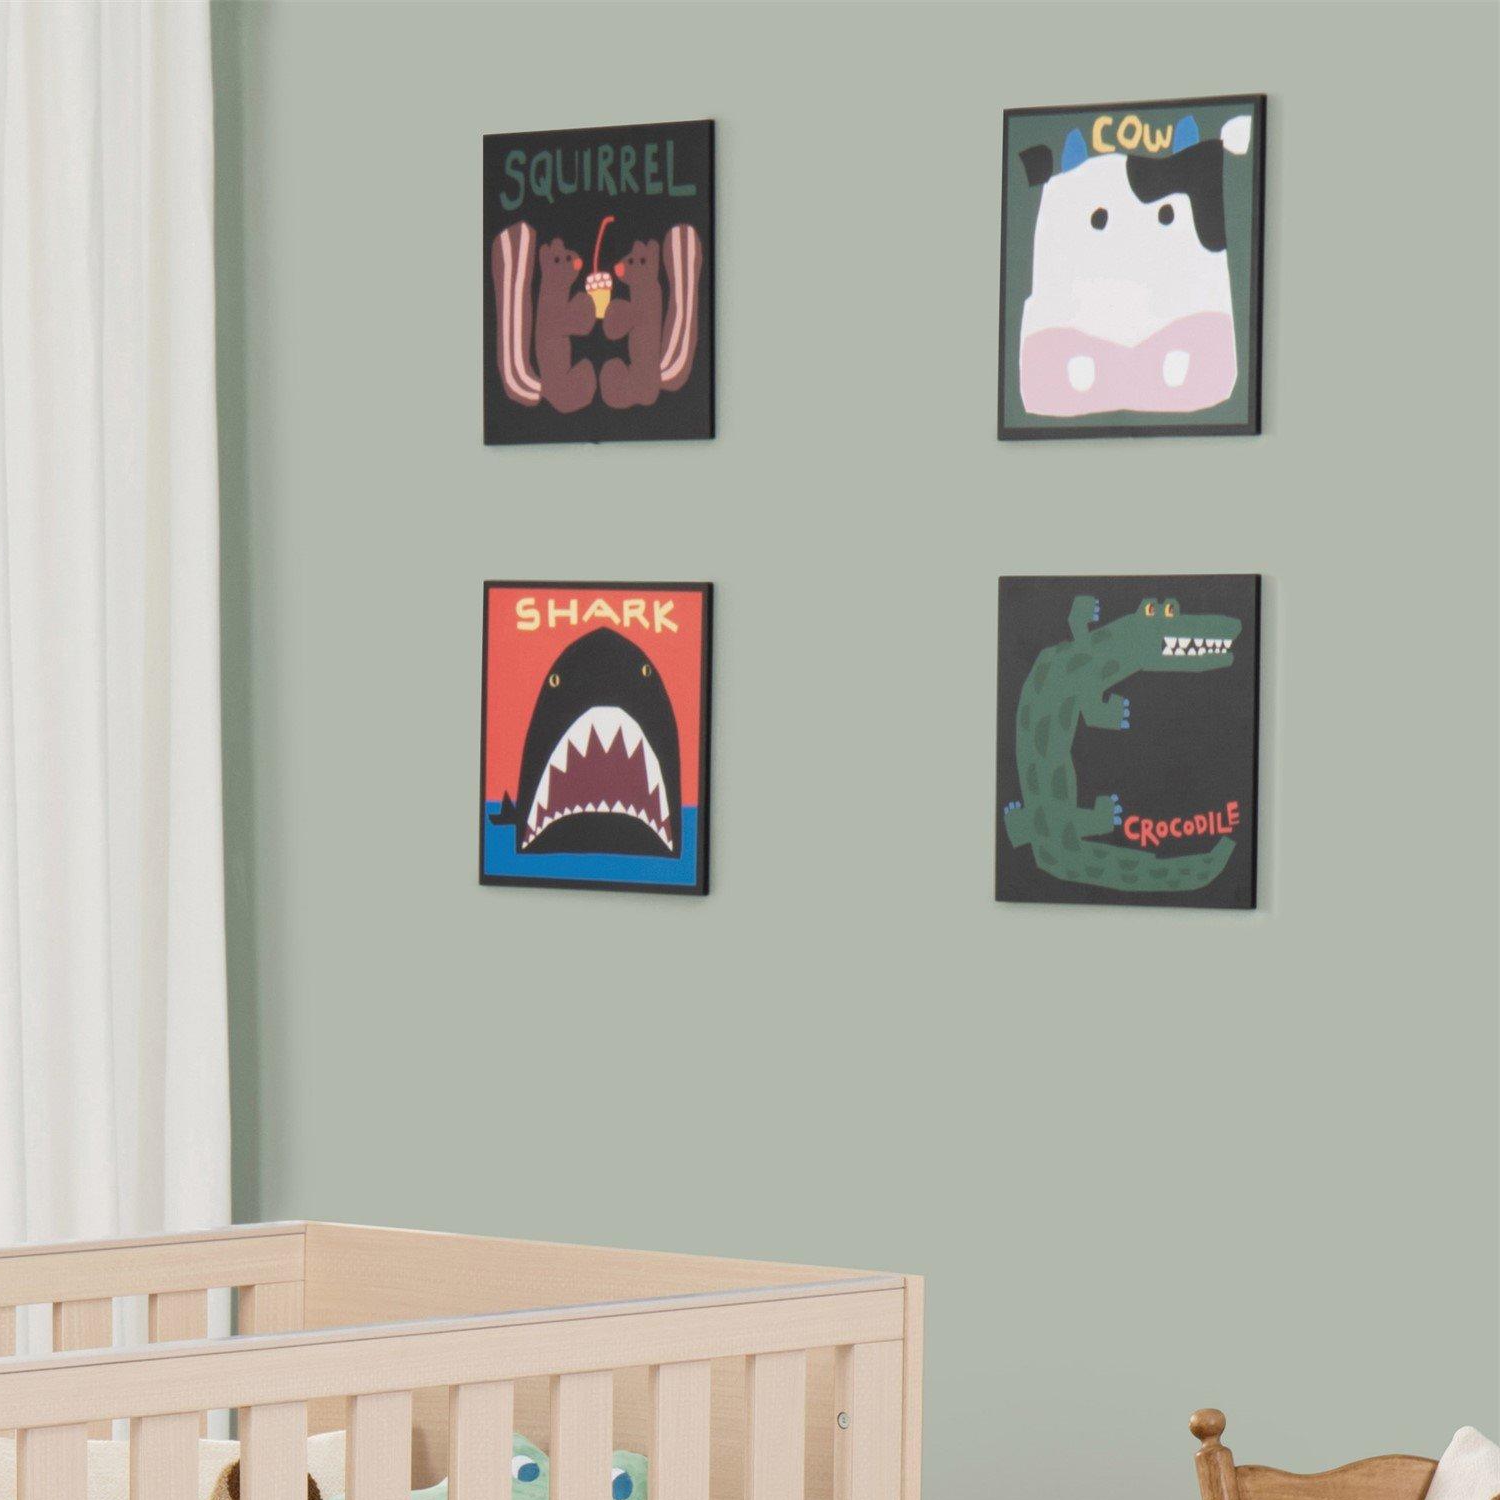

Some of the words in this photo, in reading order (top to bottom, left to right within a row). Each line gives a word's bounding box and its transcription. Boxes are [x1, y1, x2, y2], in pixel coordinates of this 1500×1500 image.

[1092, 114, 1174, 153] COW
[500, 139, 698, 211] SQUIRREL
[515, 597, 680, 634] SHARK
[1124, 801, 1240, 848] CROCODILE
